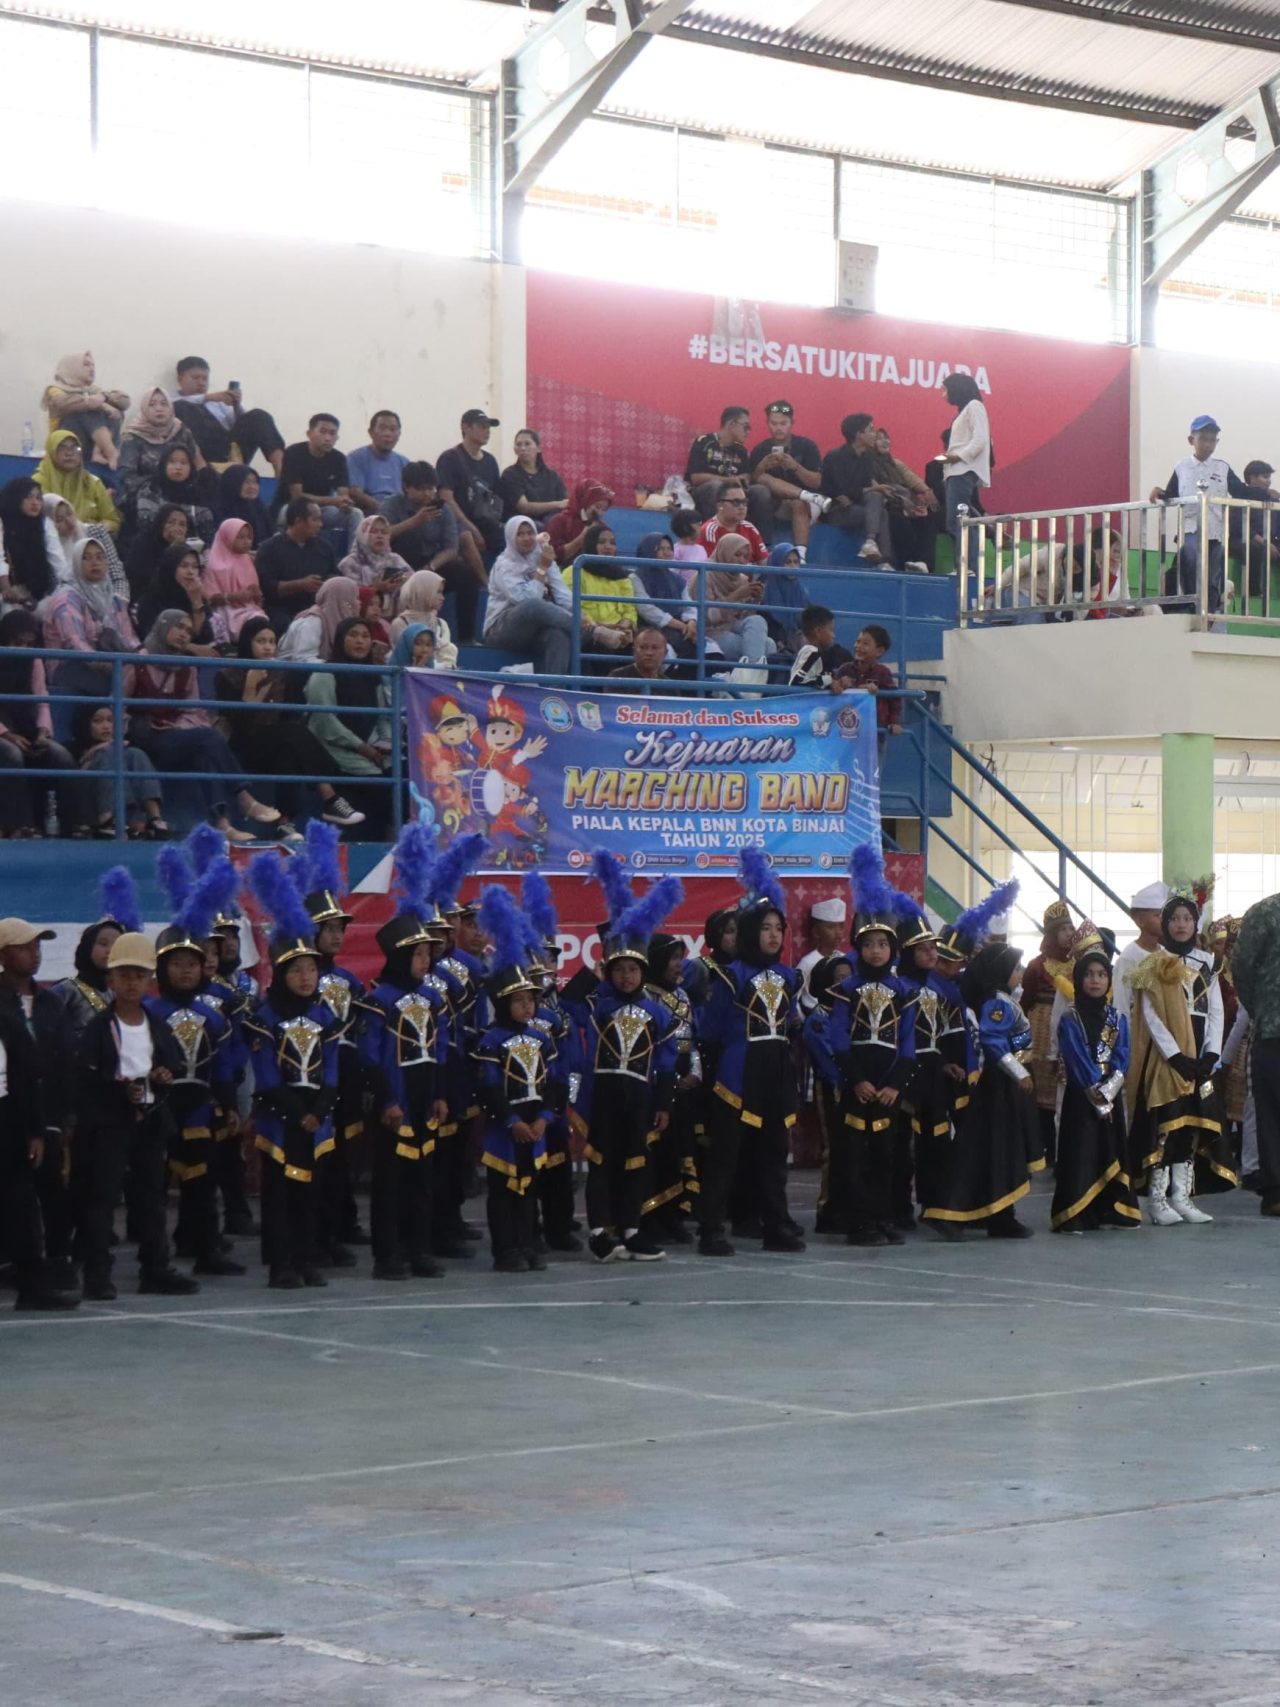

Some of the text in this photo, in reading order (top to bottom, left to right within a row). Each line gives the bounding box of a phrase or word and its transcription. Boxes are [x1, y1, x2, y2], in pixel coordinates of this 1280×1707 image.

[616, 705, 801, 727] Selamat dan Sukses
[624, 730, 797, 769] Kejuaran
[564, 767, 850, 815] MARCHING BAND
[572, 815, 845, 833] PIALA KEPALA BNN KOTA BINJAI
[660, 832, 766, 849] TAHUN 2025
